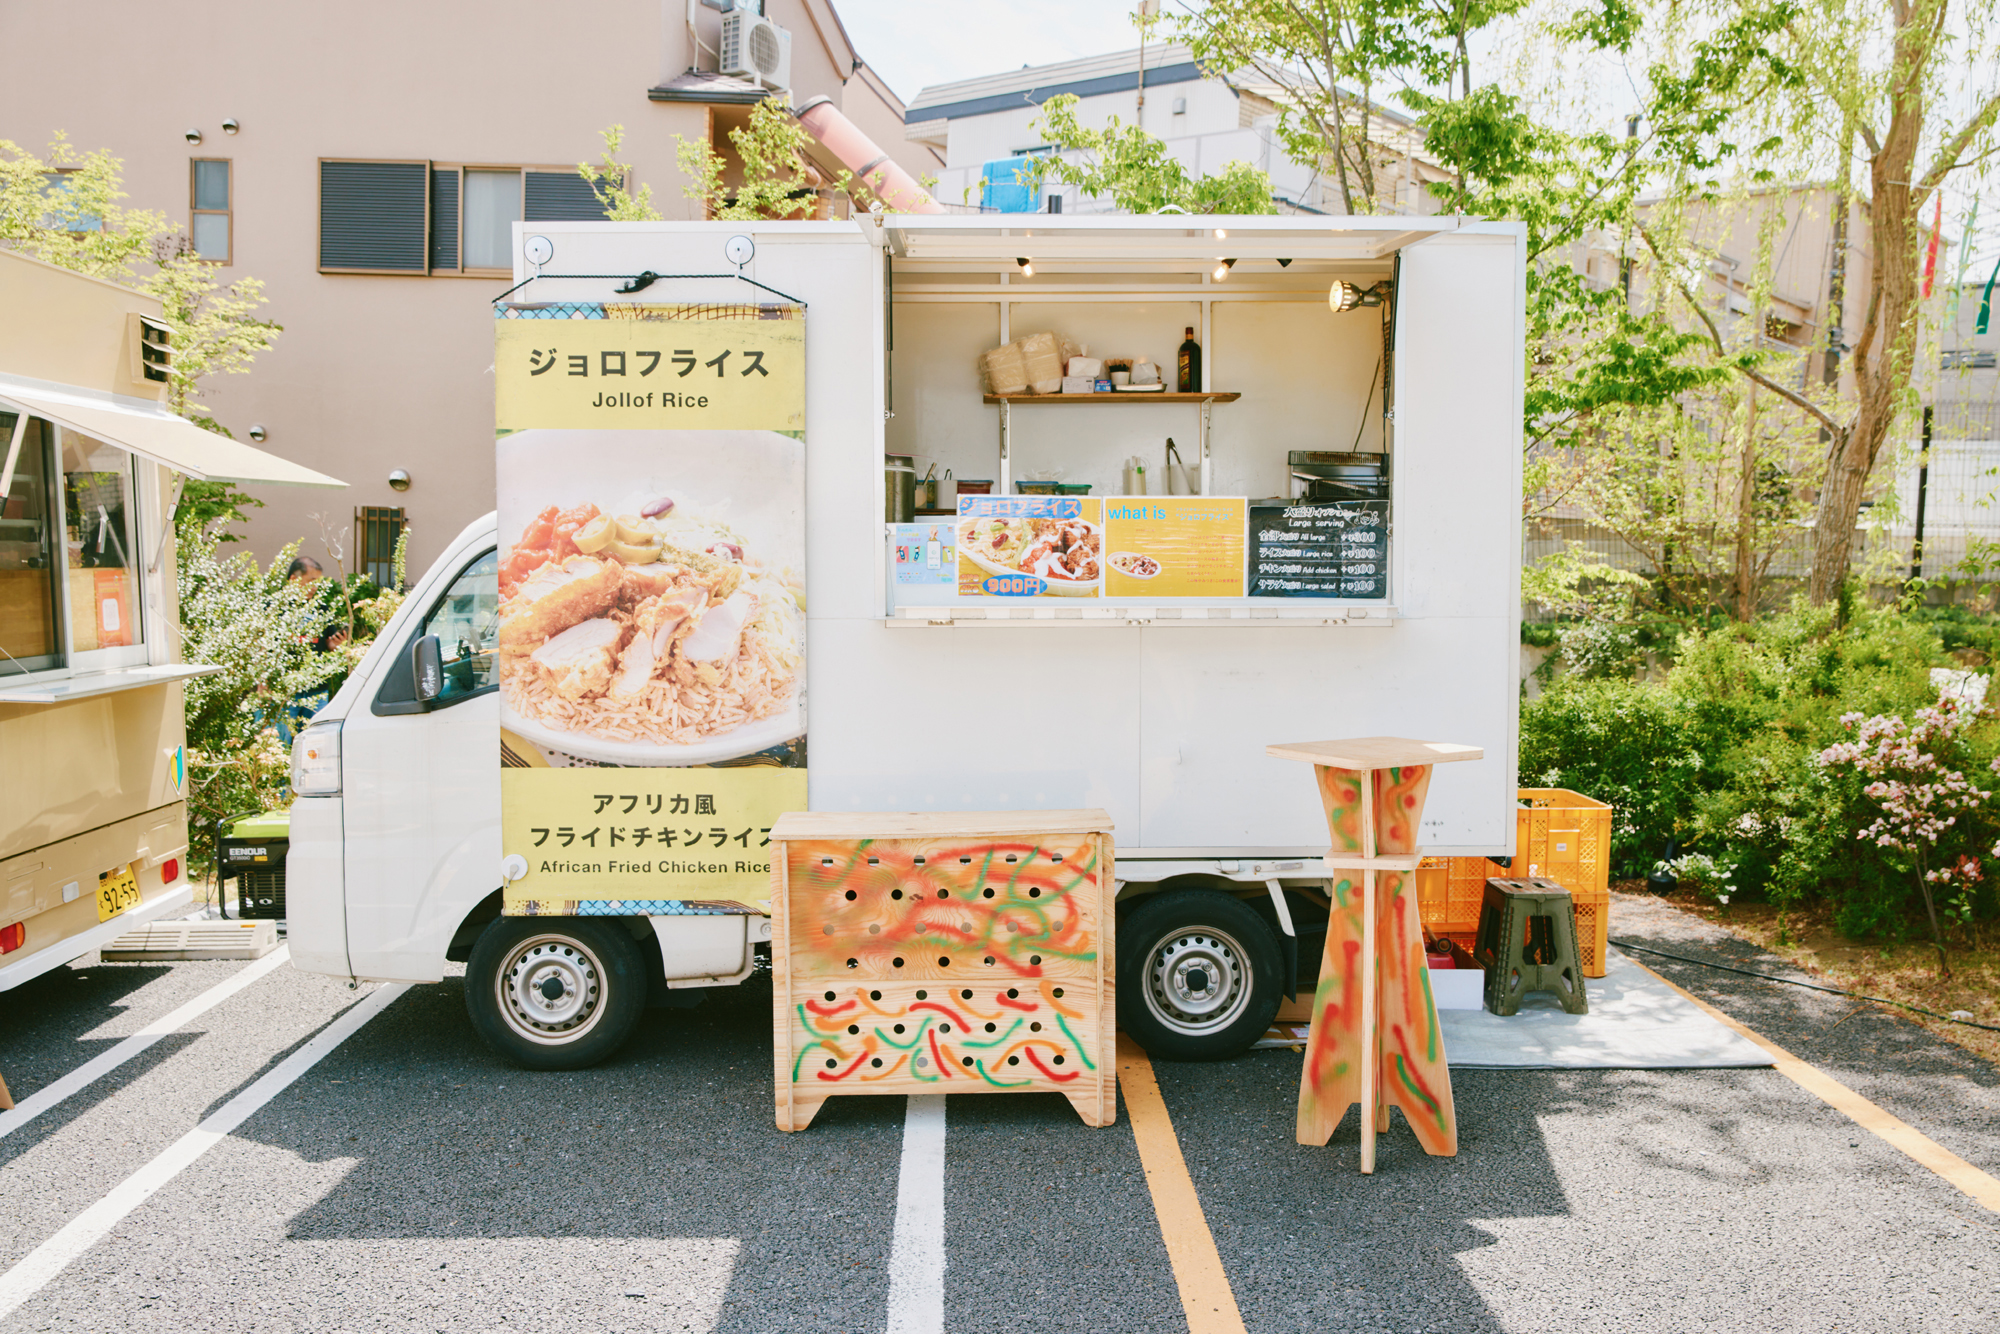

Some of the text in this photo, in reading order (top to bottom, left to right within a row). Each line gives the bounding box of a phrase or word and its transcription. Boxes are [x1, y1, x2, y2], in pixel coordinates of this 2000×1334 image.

[529, 348, 770, 378] ジョロフライス
[592, 392, 709, 408] Jollof Rice
[961, 498, 1079, 516] ジョロフライス
[1108, 505, 1166, 520] what is
[1289, 519, 1345, 528] Large serving
[1303, 550, 1320, 558] Large
[987, 578, 1040, 594] 900円
[593, 794, 716, 816] アフリカ風
[531, 827, 772, 848] フライドチキンライス
[540, 860, 771, 874] African Fried Chicken Rice
